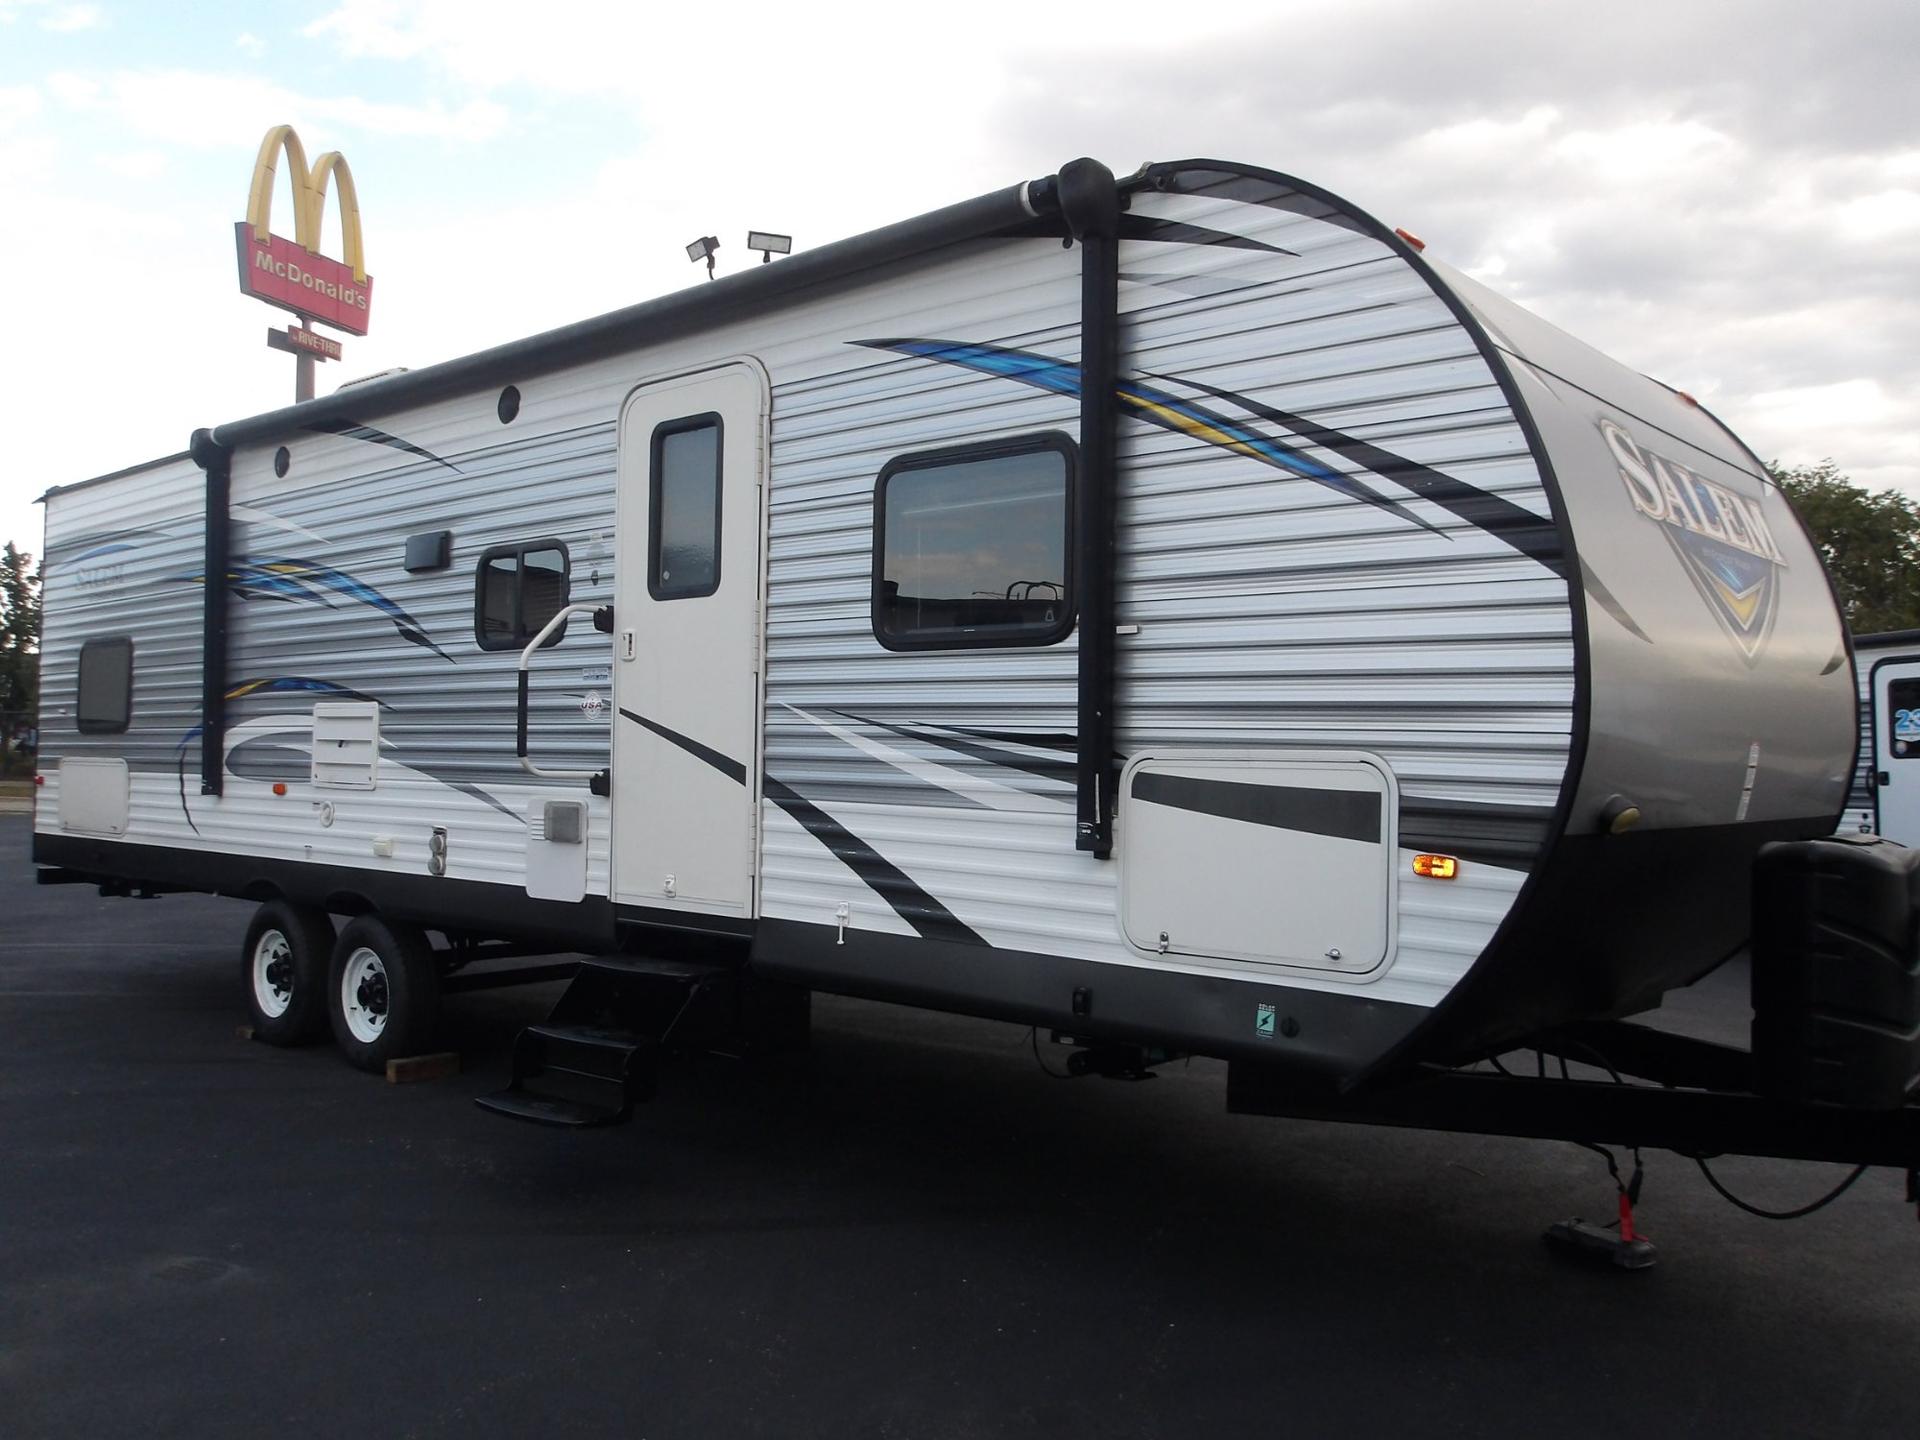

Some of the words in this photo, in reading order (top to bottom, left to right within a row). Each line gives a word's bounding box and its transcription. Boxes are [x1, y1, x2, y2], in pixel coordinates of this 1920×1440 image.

[255, 249, 367, 311] McDonald's
[1600, 418, 1788, 568] SALEM
[581, 701, 603, 710] USA
